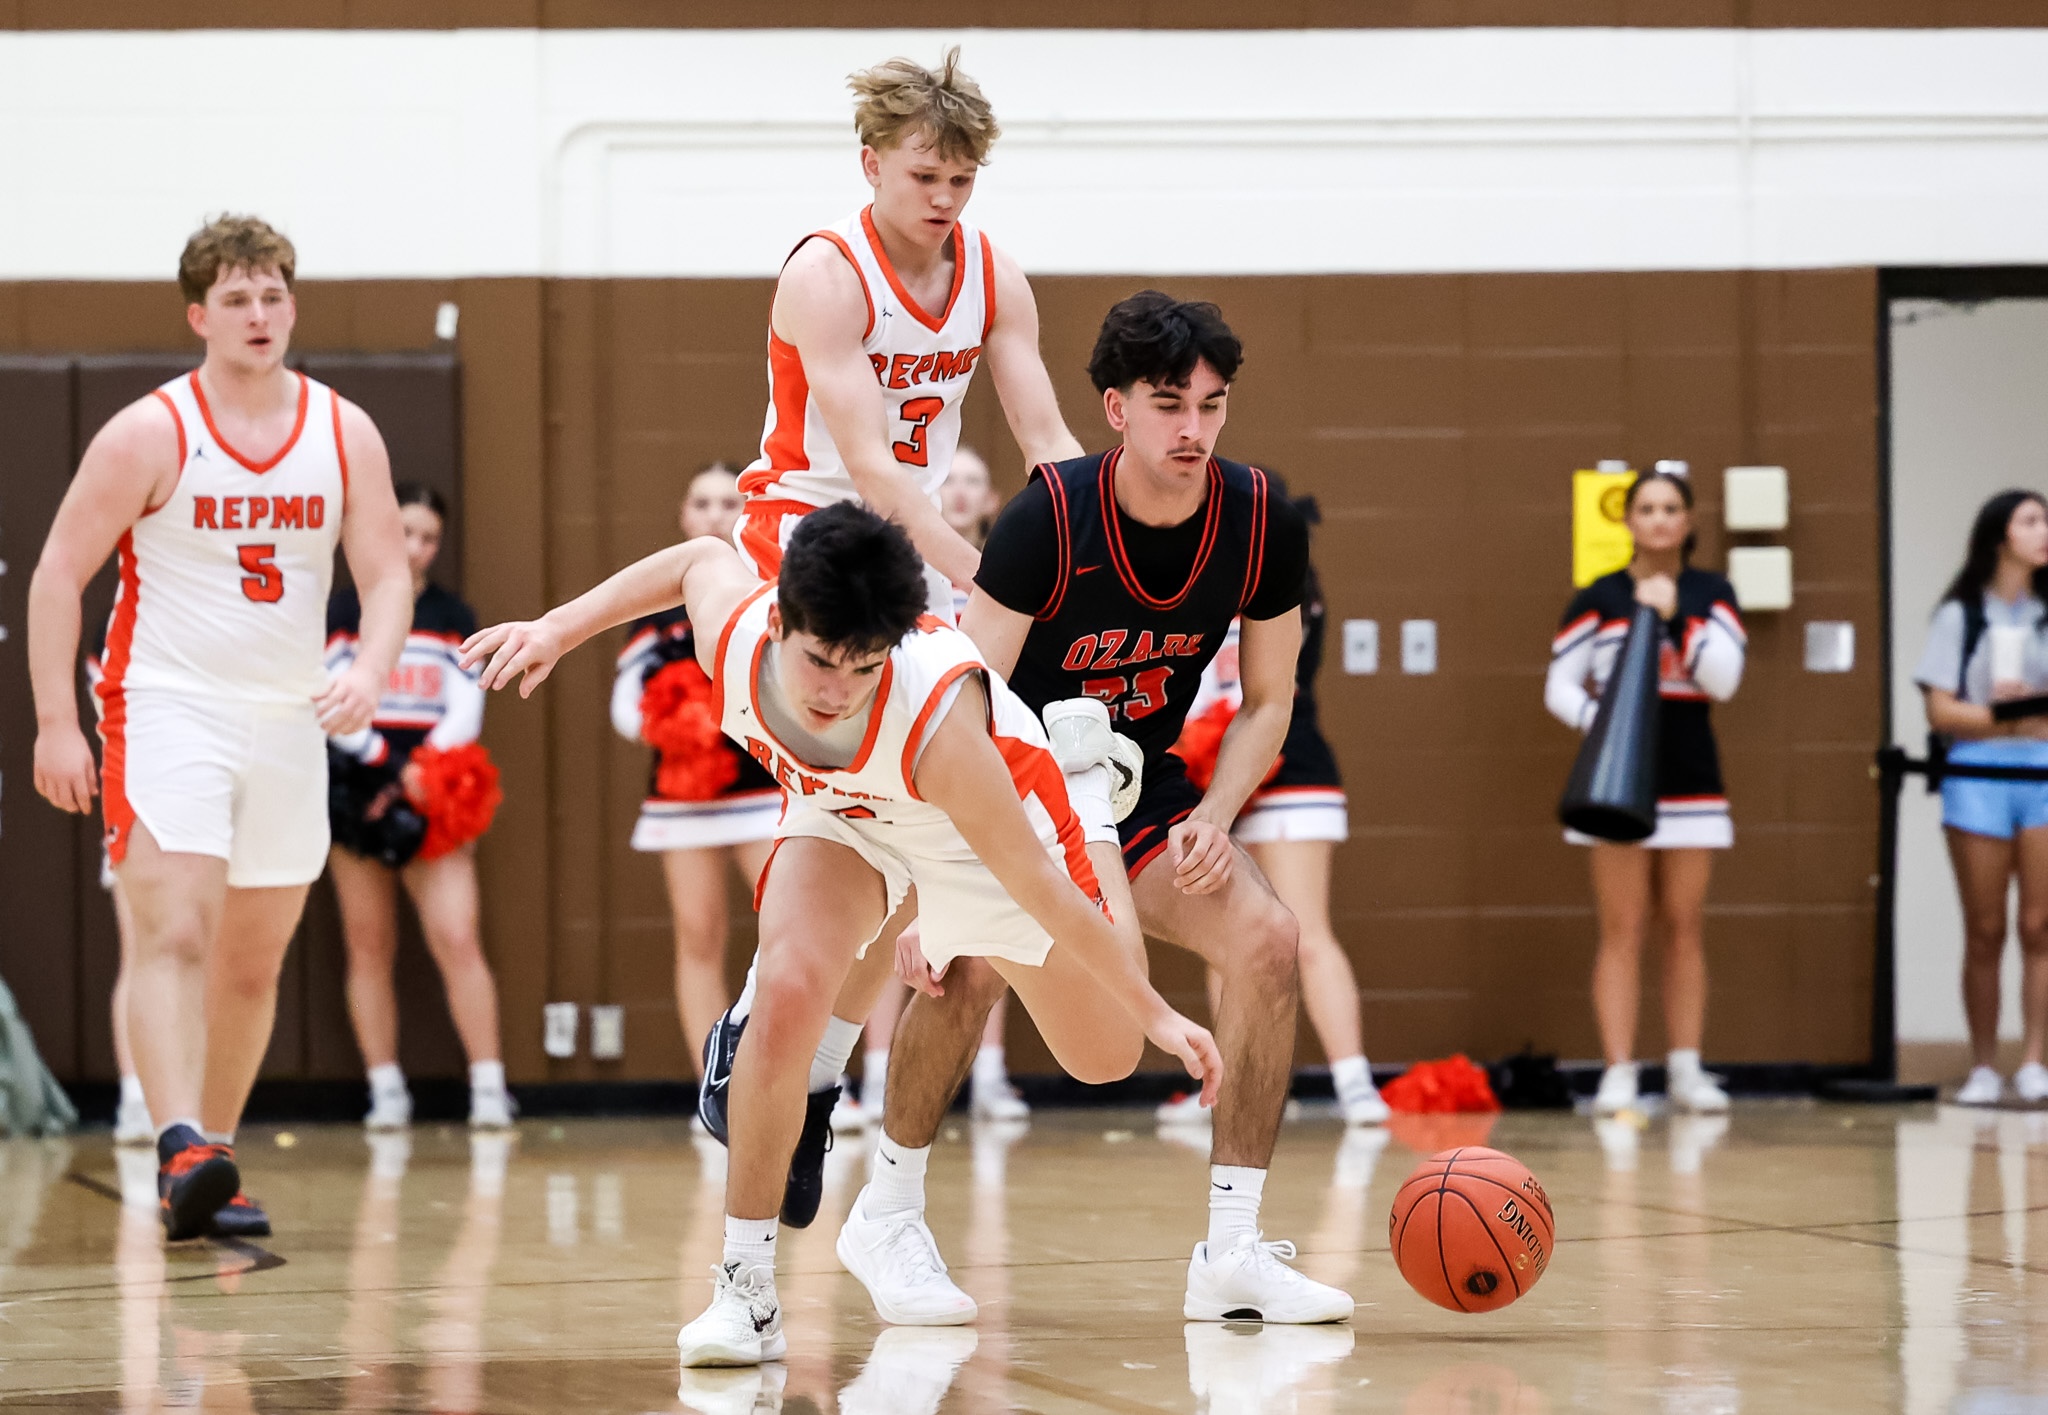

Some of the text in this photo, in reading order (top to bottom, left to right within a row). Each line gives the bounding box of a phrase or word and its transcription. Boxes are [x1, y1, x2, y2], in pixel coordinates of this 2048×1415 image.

[892, 396, 944, 467] 3
[193, 495, 325, 529] REPMO
[237, 544, 284, 603] 5
